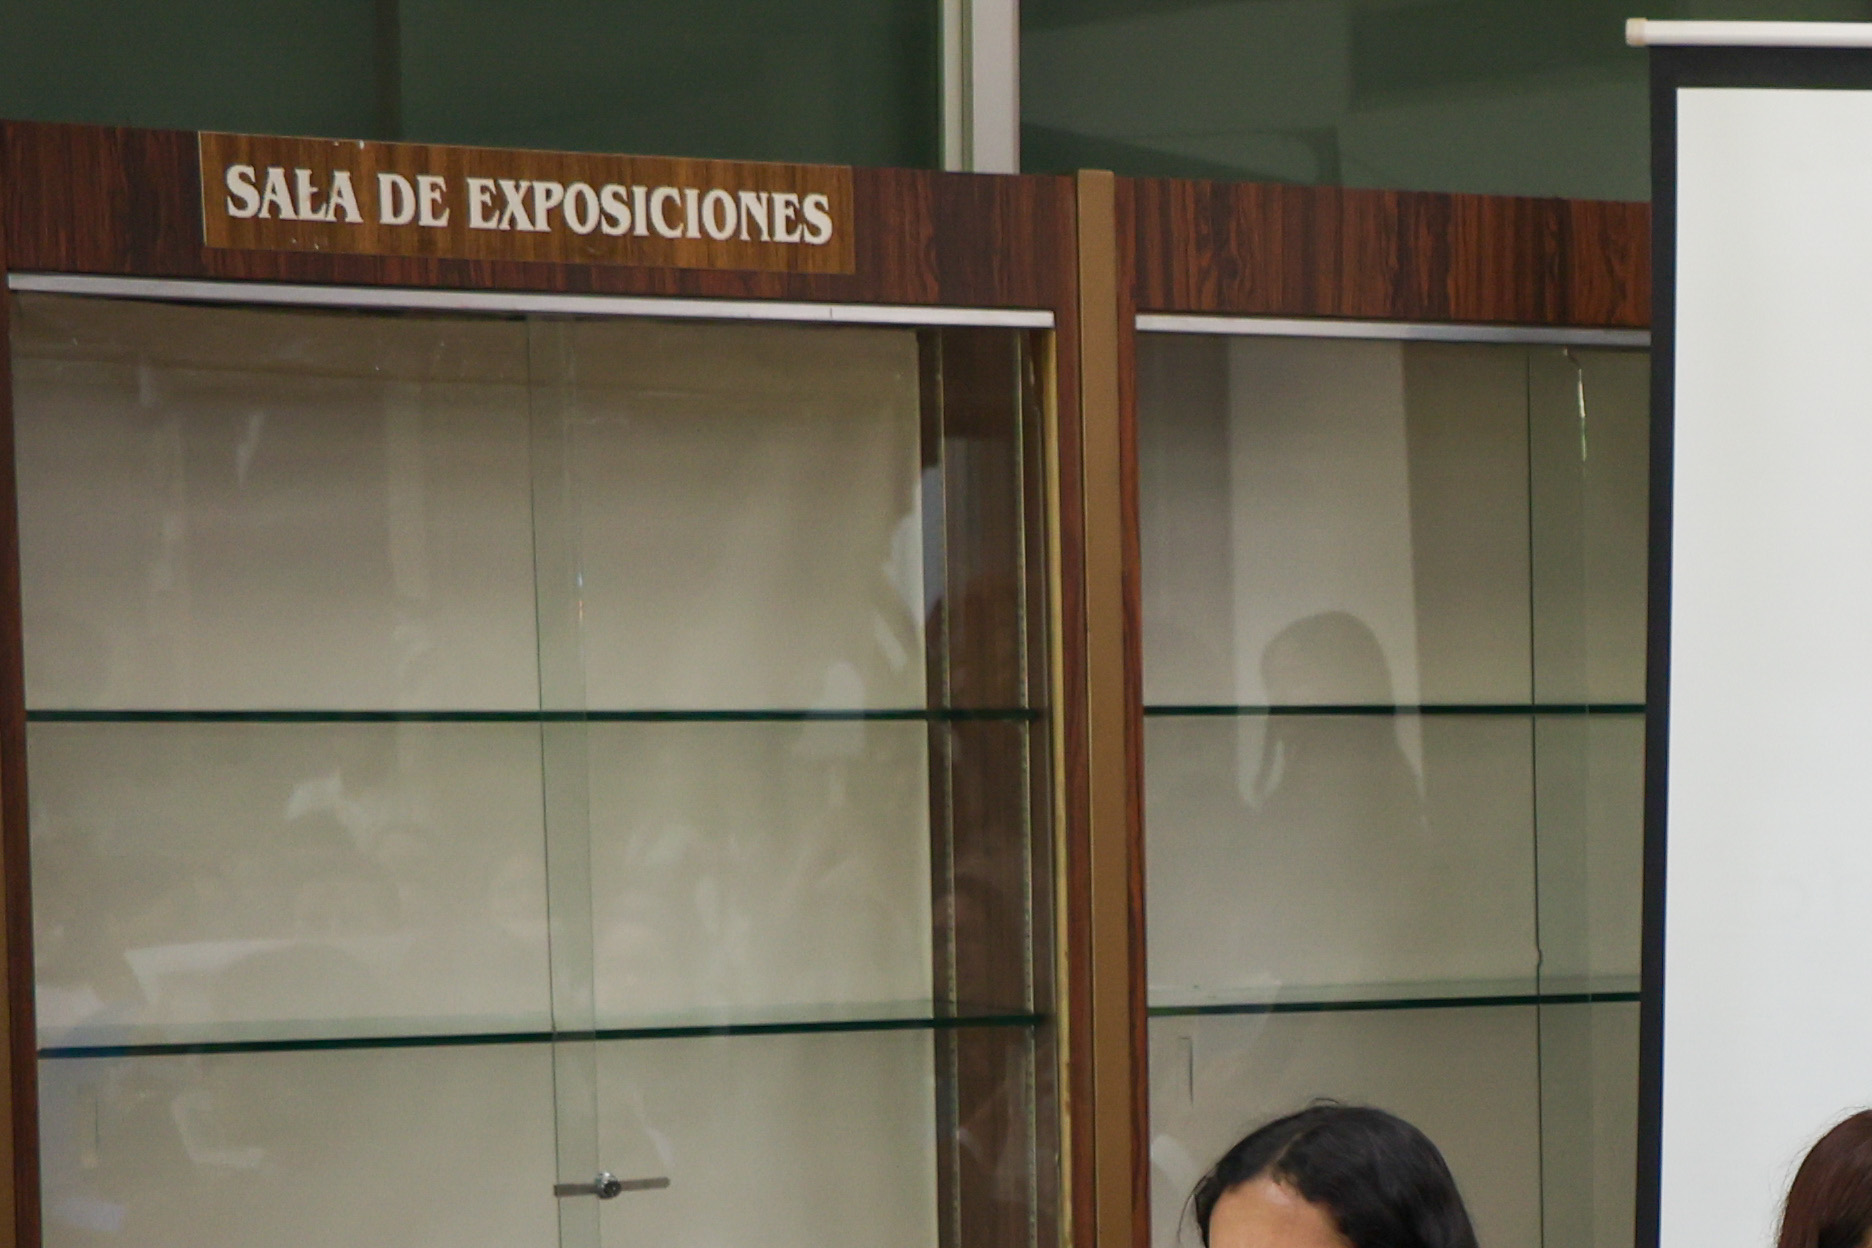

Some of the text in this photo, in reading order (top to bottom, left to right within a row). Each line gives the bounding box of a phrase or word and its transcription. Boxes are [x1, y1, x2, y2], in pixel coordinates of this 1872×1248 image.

[226, 165, 833, 245] SALA DE EXPOSICIONES
